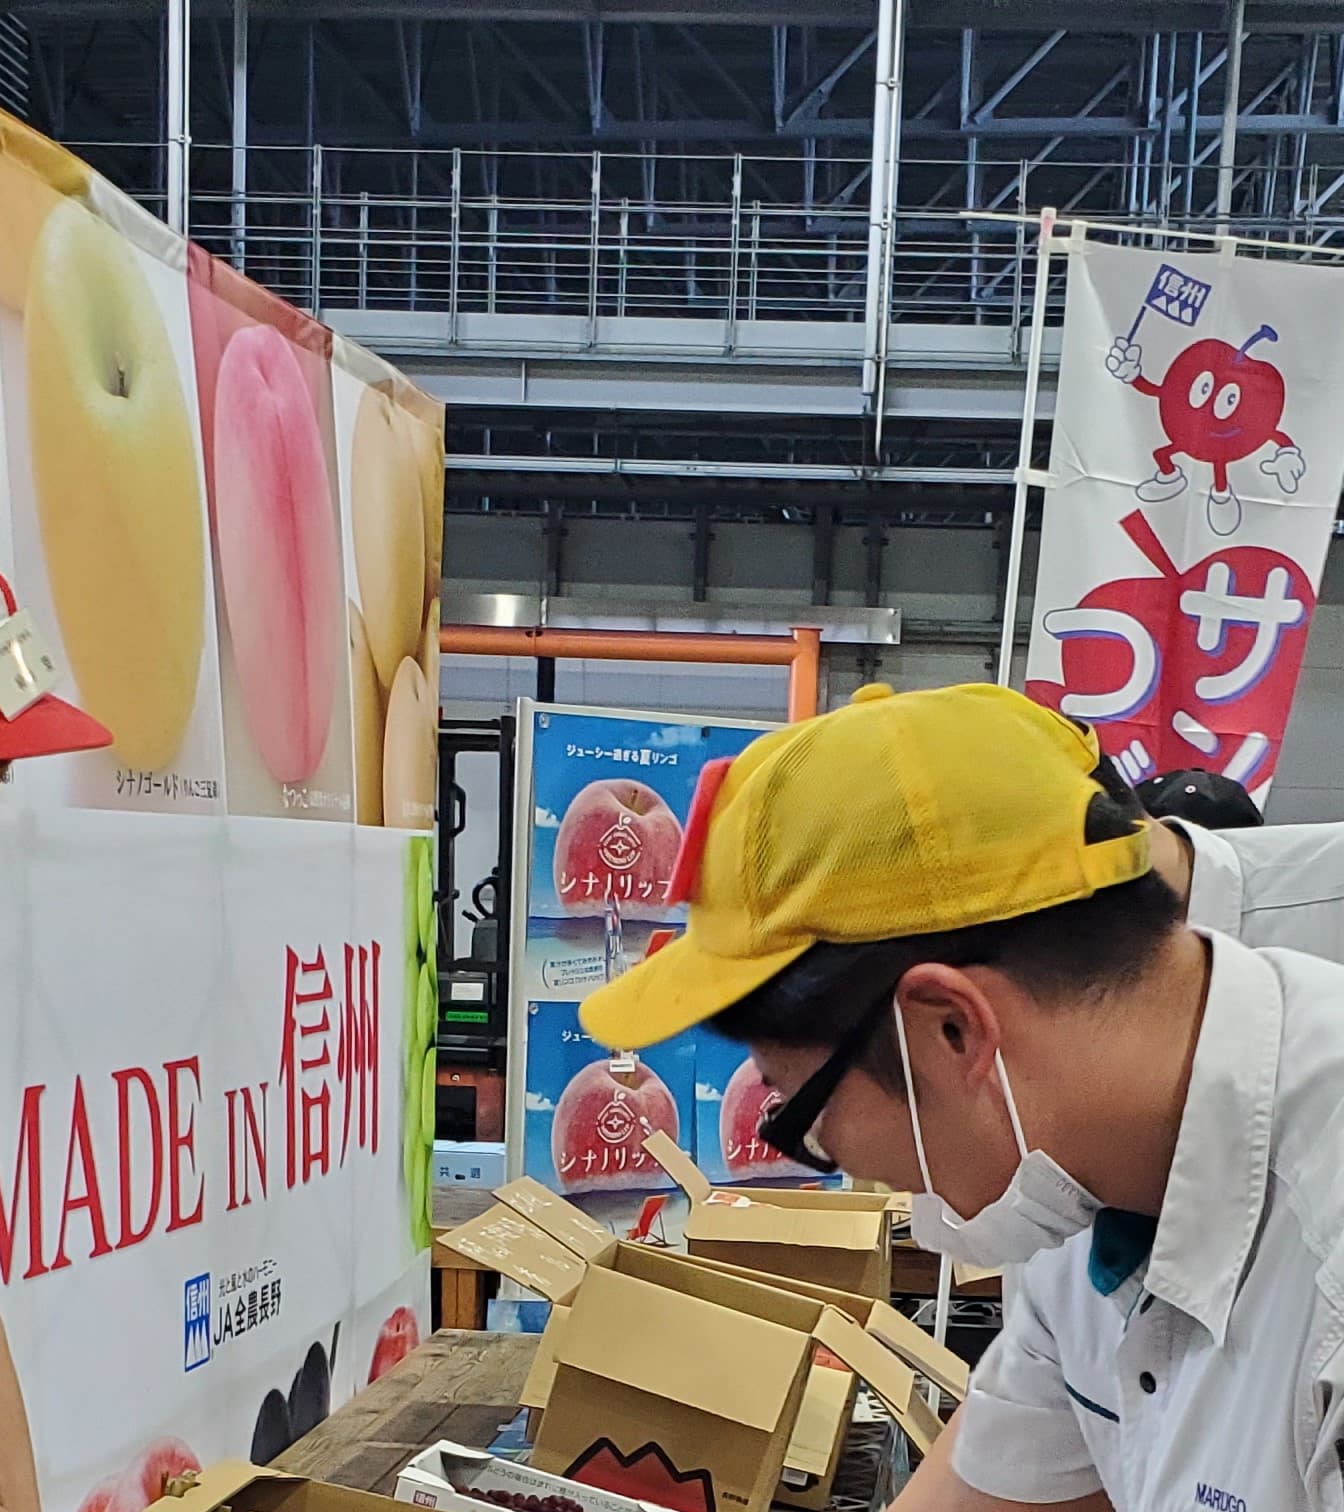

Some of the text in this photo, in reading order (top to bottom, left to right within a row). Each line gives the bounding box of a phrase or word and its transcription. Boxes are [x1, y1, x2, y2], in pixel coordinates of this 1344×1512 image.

[1158, 270, 1206, 308] 信州
[224, 1082, 270, 1212] IN
[278, 939, 382, 1191] 信州
[186, 1278, 210, 1323] 信州
[213, 1278, 282, 1346] JA全農長野
